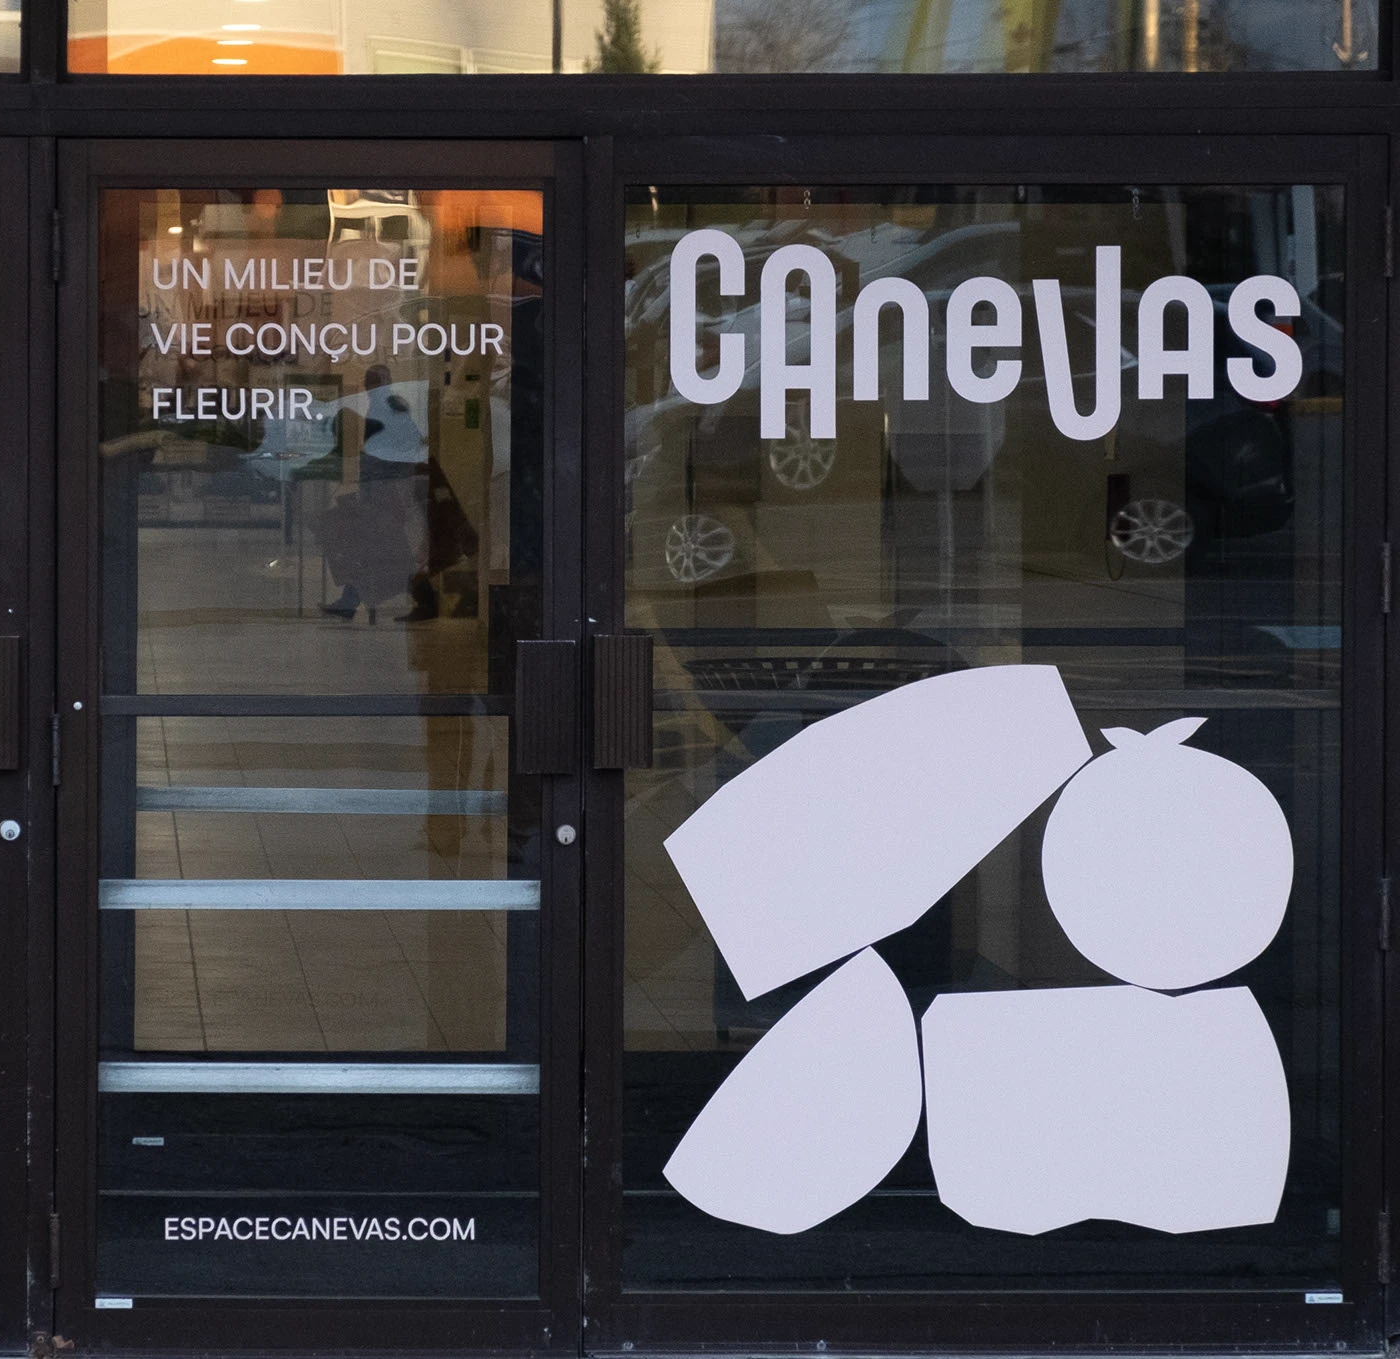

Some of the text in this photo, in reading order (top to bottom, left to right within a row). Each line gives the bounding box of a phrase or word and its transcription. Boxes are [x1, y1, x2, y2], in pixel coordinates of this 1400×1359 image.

[152, 258, 419, 290] UN MILIEU DE
[150, 322, 212, 355] VIE
[225, 322, 377, 363] CONÇU
[392, 322, 505, 355] POUR
[152, 387, 324, 420] FLEURIR.
[164, 1217, 476, 1241] ESPACECANEVAS.COM
